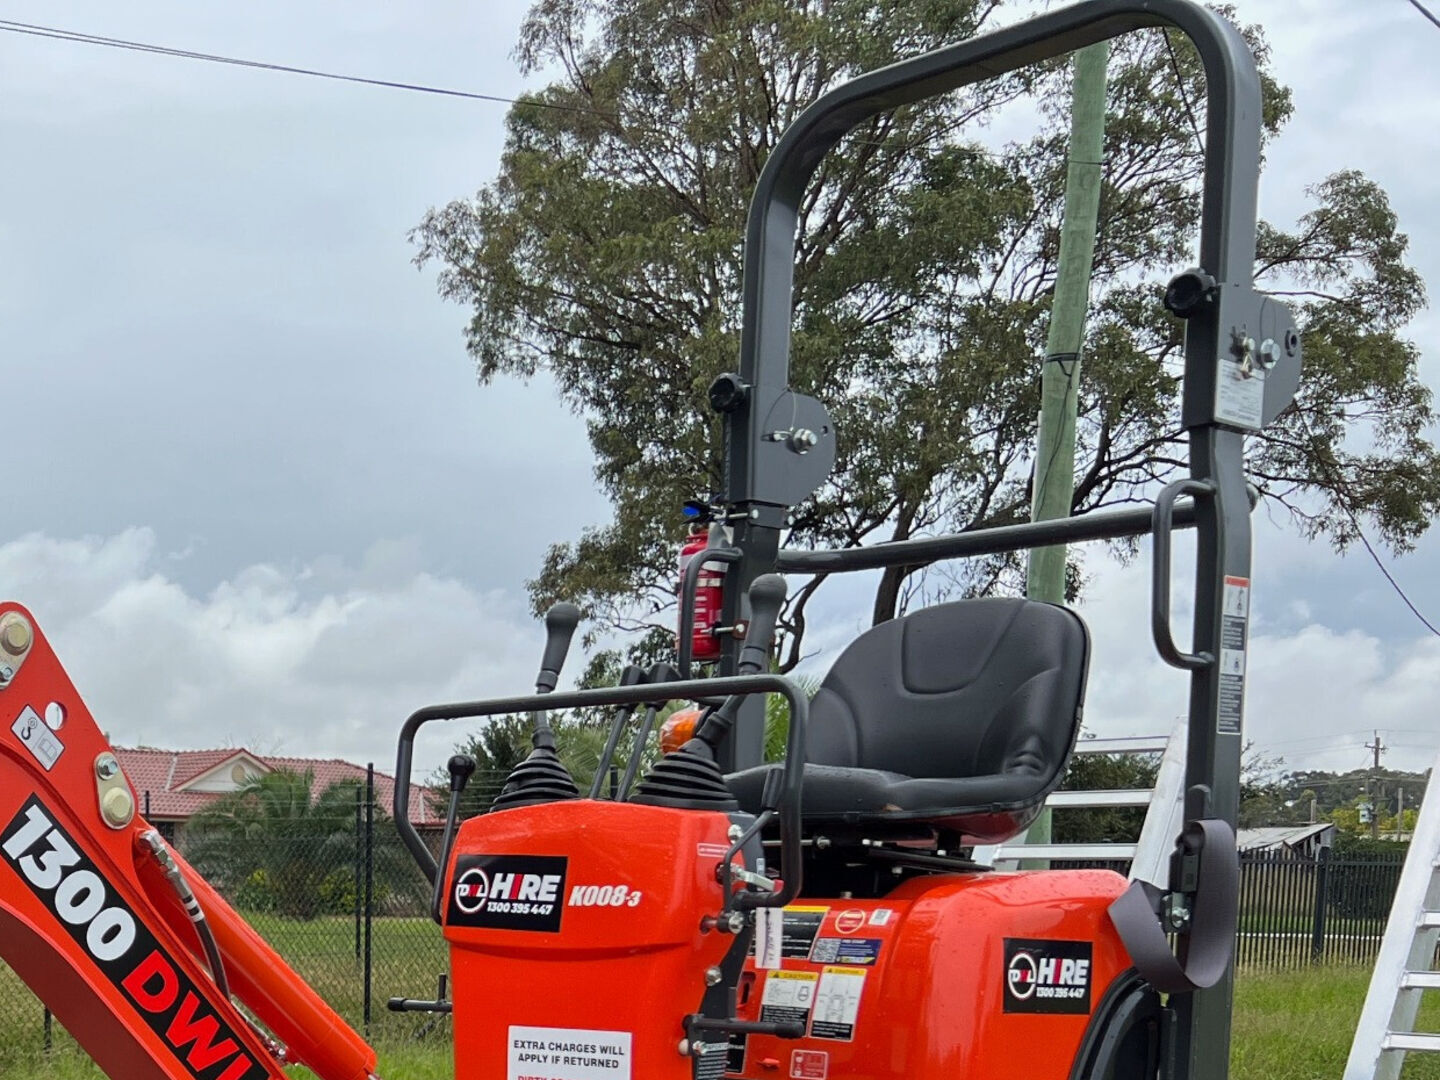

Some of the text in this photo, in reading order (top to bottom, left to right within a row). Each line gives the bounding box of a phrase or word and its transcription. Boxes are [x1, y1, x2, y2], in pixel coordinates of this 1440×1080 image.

[1, 803, 136, 961] 1300
[489, 873, 561, 902] HIRE
[568, 885, 642, 907] K008-3
[487, 902, 553, 915] 1300 395 447
[1038, 958, 1089, 985] HIRE
[1036, 986, 1085, 998] 1300 395 447
[514, 1040, 624, 1055] EXTRA CHARGES WILL
[518, 1053, 619, 1069] APPLY IF RETURNED
